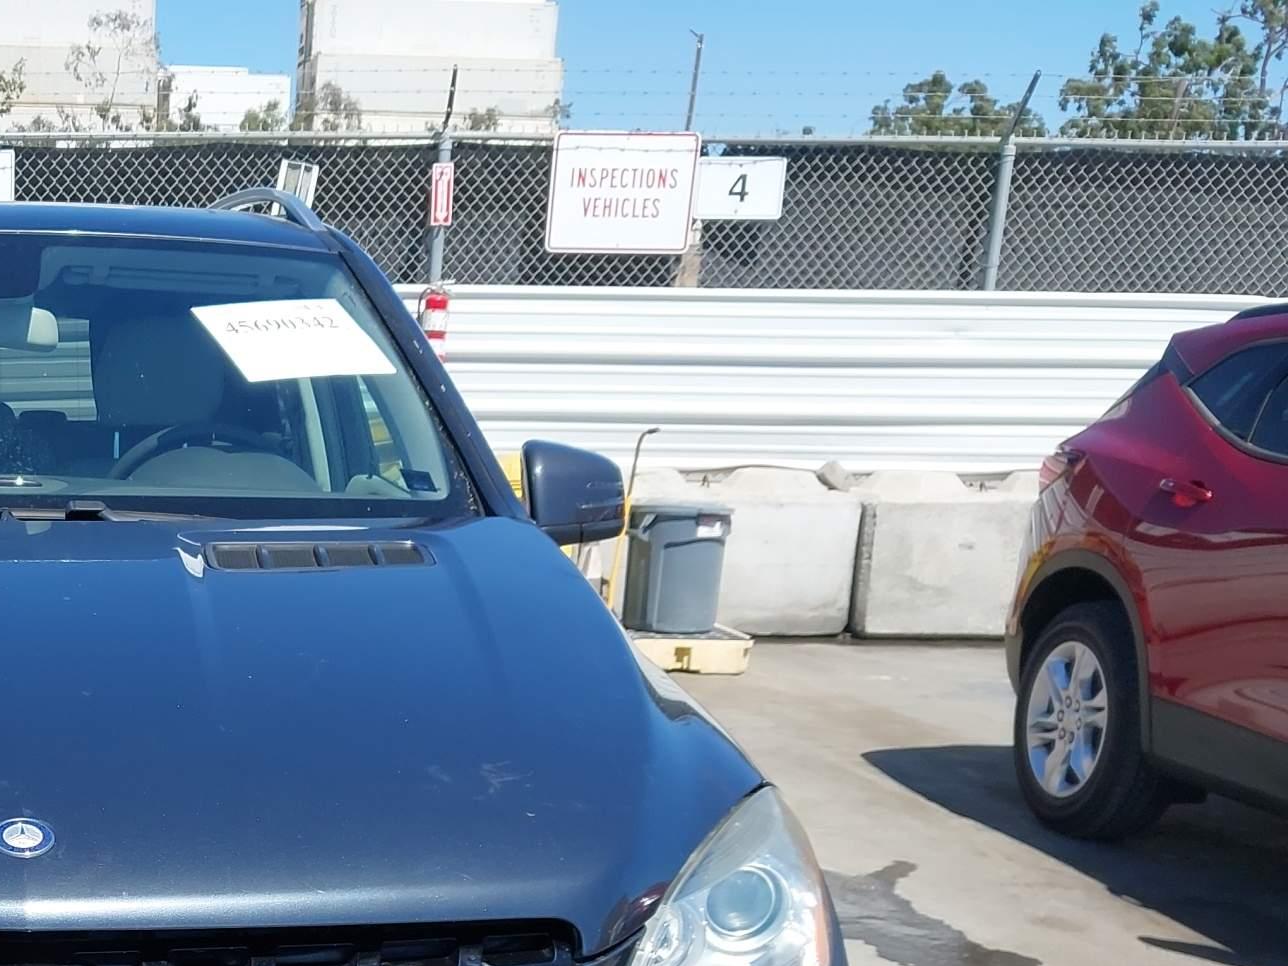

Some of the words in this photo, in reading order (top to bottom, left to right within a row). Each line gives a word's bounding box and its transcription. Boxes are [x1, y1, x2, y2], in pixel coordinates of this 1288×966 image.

[569, 167, 679, 190] INSPECTIONS
[727, 173, 749, 203] 4
[582, 197, 661, 219] VEHICLES
